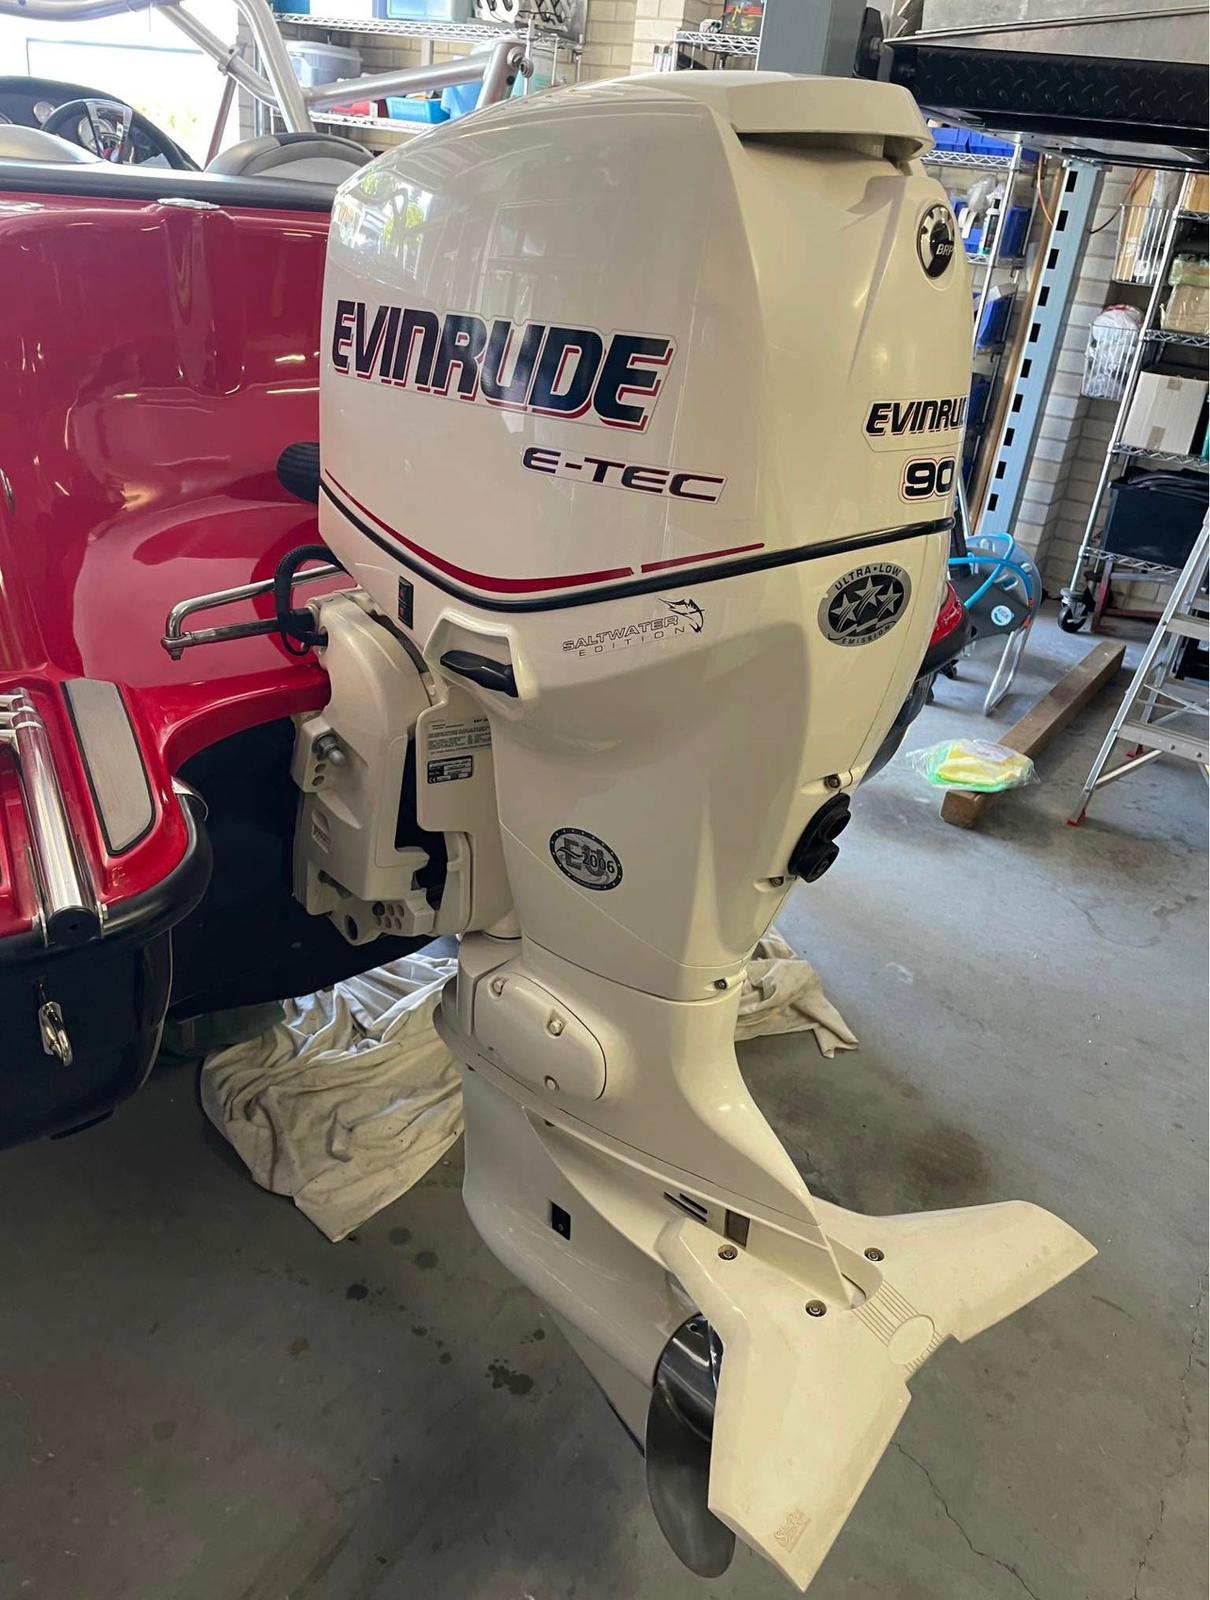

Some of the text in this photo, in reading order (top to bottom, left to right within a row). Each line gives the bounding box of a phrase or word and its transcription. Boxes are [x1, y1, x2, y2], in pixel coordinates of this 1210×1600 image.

[936, 243, 954, 257] BRP
[331, 299, 674, 432] EVINRUDE
[522, 446, 724, 502] E-TEC
[902, 457, 957, 499] 90
[562, 614, 680, 652] SALTWATER
[578, 625, 686, 657] EDITION
